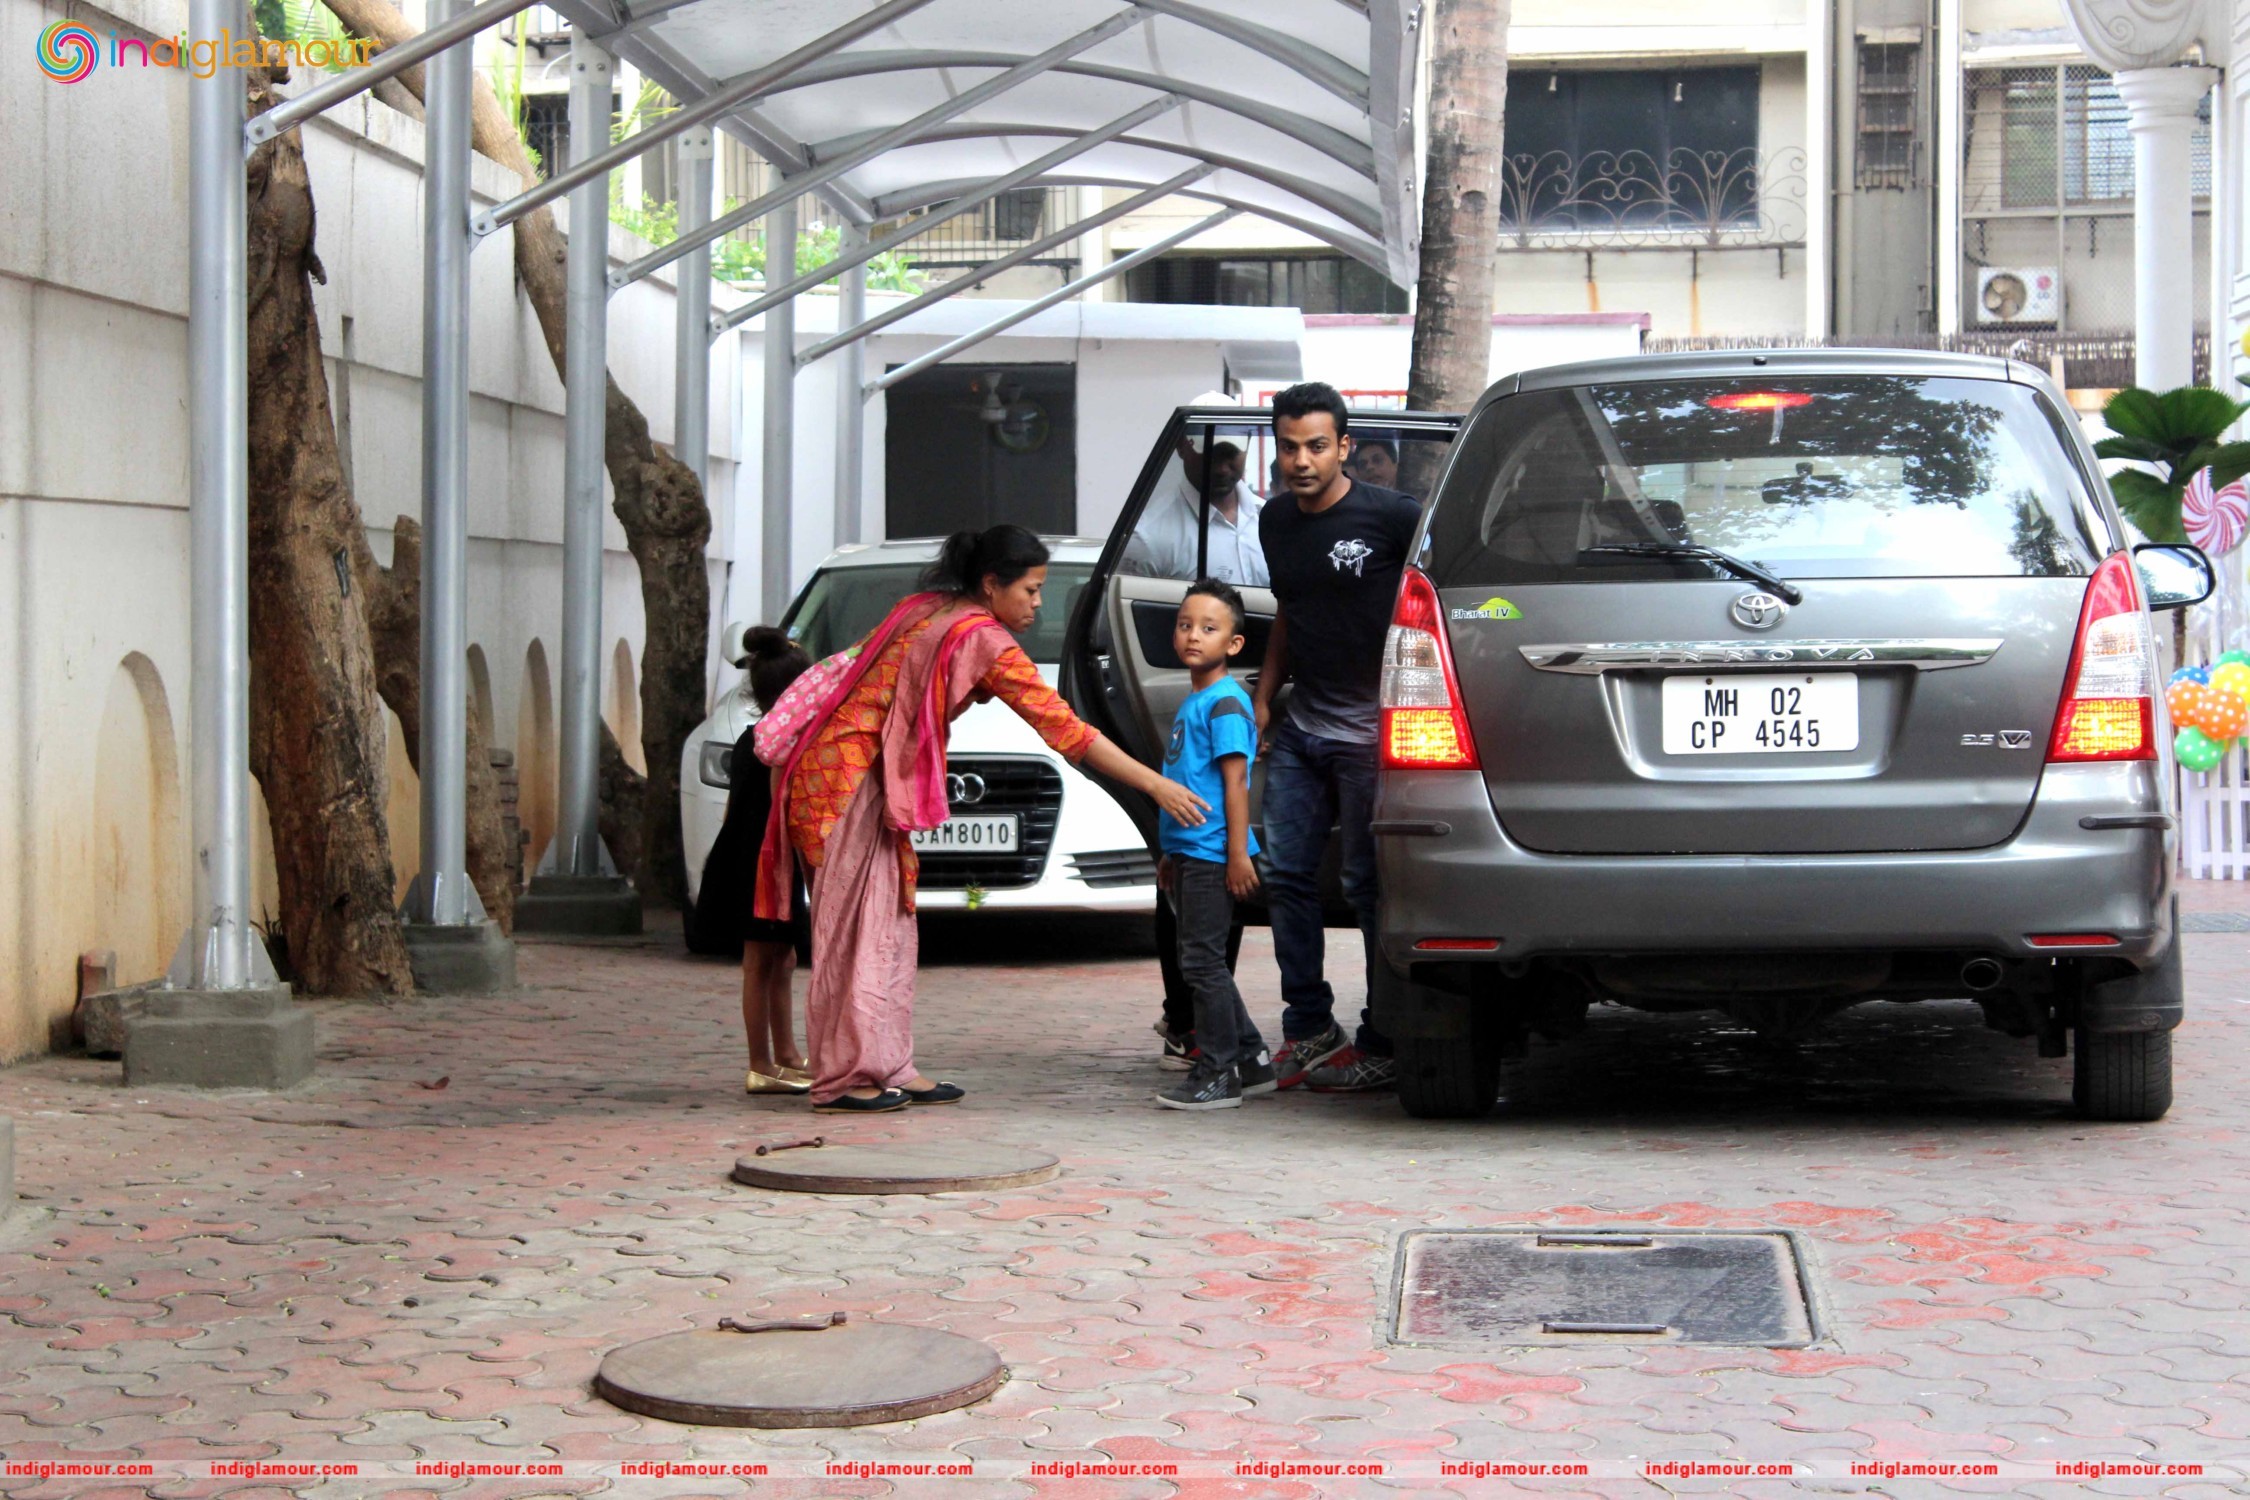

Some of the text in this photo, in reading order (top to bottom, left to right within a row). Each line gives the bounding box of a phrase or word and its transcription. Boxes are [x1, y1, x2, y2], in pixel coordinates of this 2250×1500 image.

[1452, 607, 1510, 619] Bharat IV
[1650, 648, 1875, 663] INNOVA
[1705, 687, 1802, 717] MH 02
[1692, 719, 1820, 748] CP 4545
